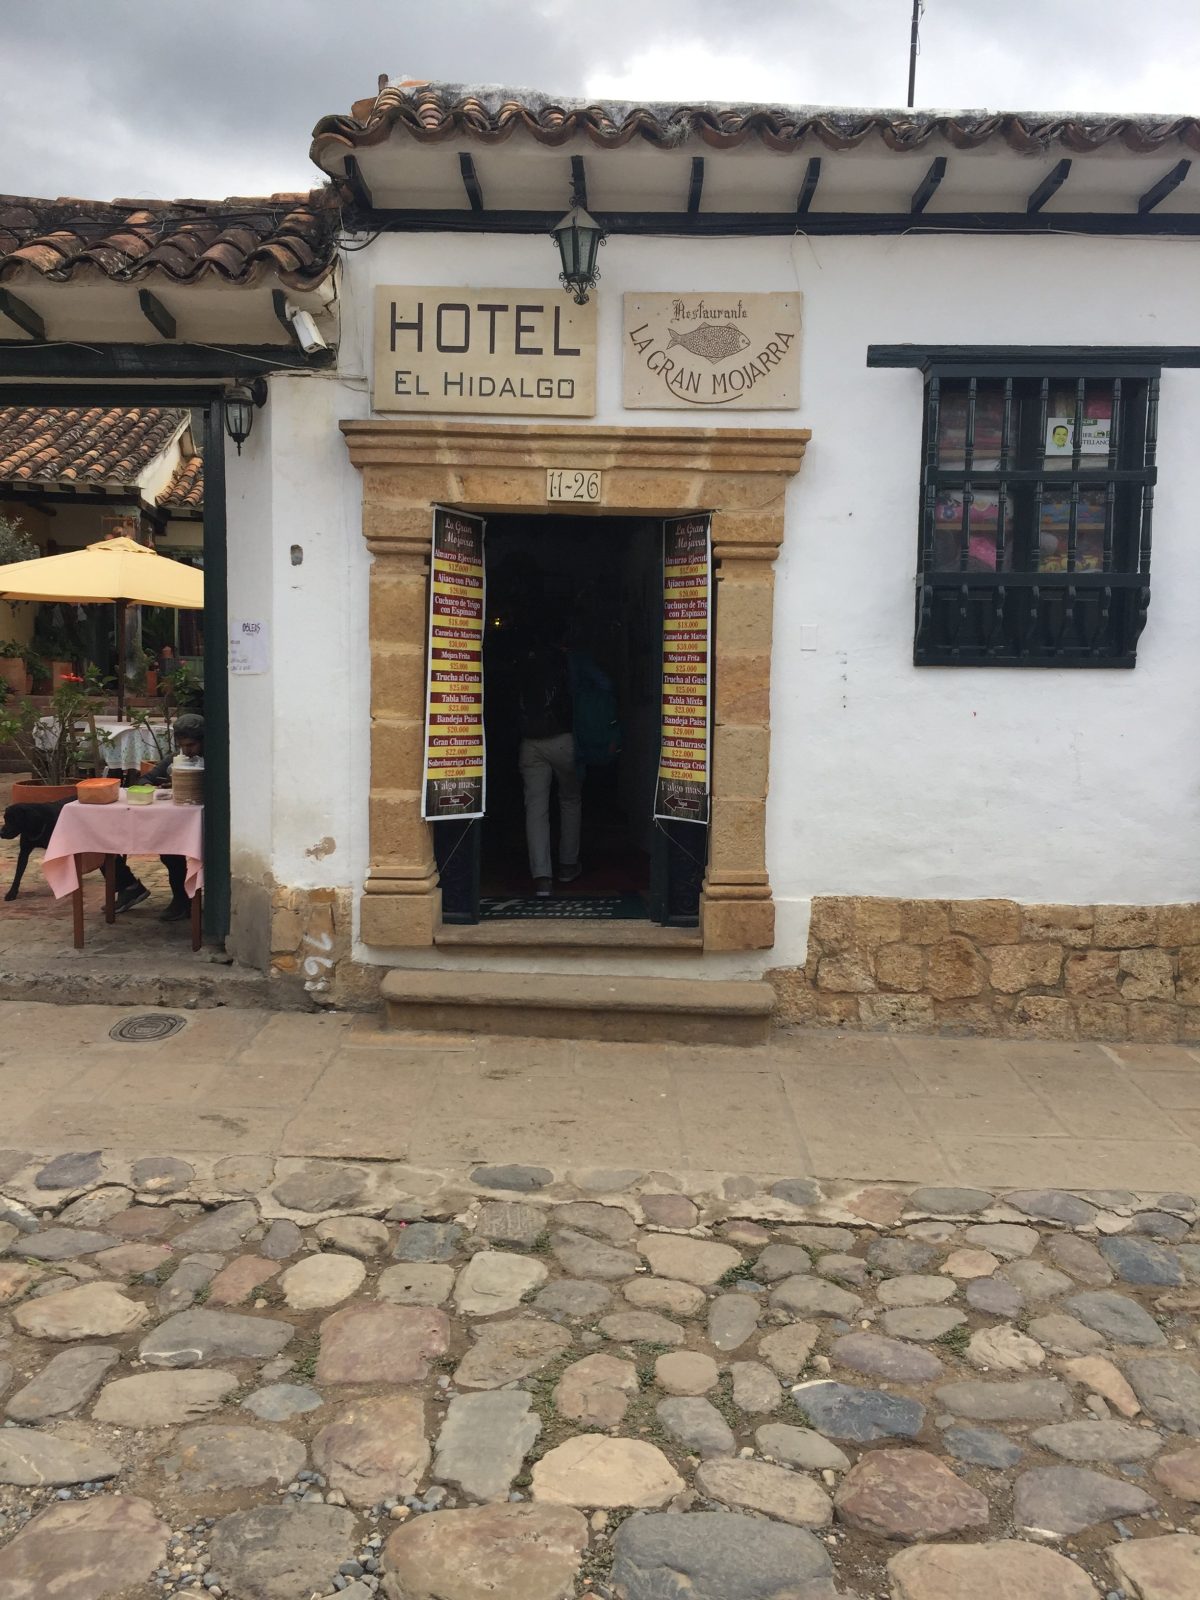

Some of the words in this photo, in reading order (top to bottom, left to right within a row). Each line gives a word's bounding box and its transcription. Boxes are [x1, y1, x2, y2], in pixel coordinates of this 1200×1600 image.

[671, 299, 749, 324] Restaurante
[390, 302, 581, 356] HOTEL
[629, 323, 655, 354] LA
[646, 350, 715, 400] GRAN
[711, 331, 795, 395] MOJARRA
[549, 471, 599, 499] 11-26
[434, 595, 459, 606] Cuchuco
[459, 598, 466, 607] de
[466, 599, 480, 610] Trigo
[688, 600, 696, 609] de
[441, 606, 450, 614] con
[682, 632, 690, 640] de
[436, 672, 458, 682] Trucha
[458, 673, 464, 682] al
[464, 674, 480, 682] Gusto
[664, 675, 684, 683] Trucha
[684, 675, 691, 683] al
[441, 694, 460, 703] Tabla
[460, 695, 475, 703] Mixta
[668, 695, 685, 705] Tabla
[685, 696, 704, 706] Mixta
[436, 714, 463, 725] Bandeja
[463, 714, 478, 723] Paisa
[663, 715, 688, 727] Bandeja
[689, 716, 706, 726] Paisa
[433, 737, 449, 746] Gran
[449, 737, 480, 746] Churrasco
[428, 757, 464, 768] Sobrebarriga
[433, 780, 440, 791] Y
[441, 780, 457, 792] algo
[667, 782, 684, 794] algo
